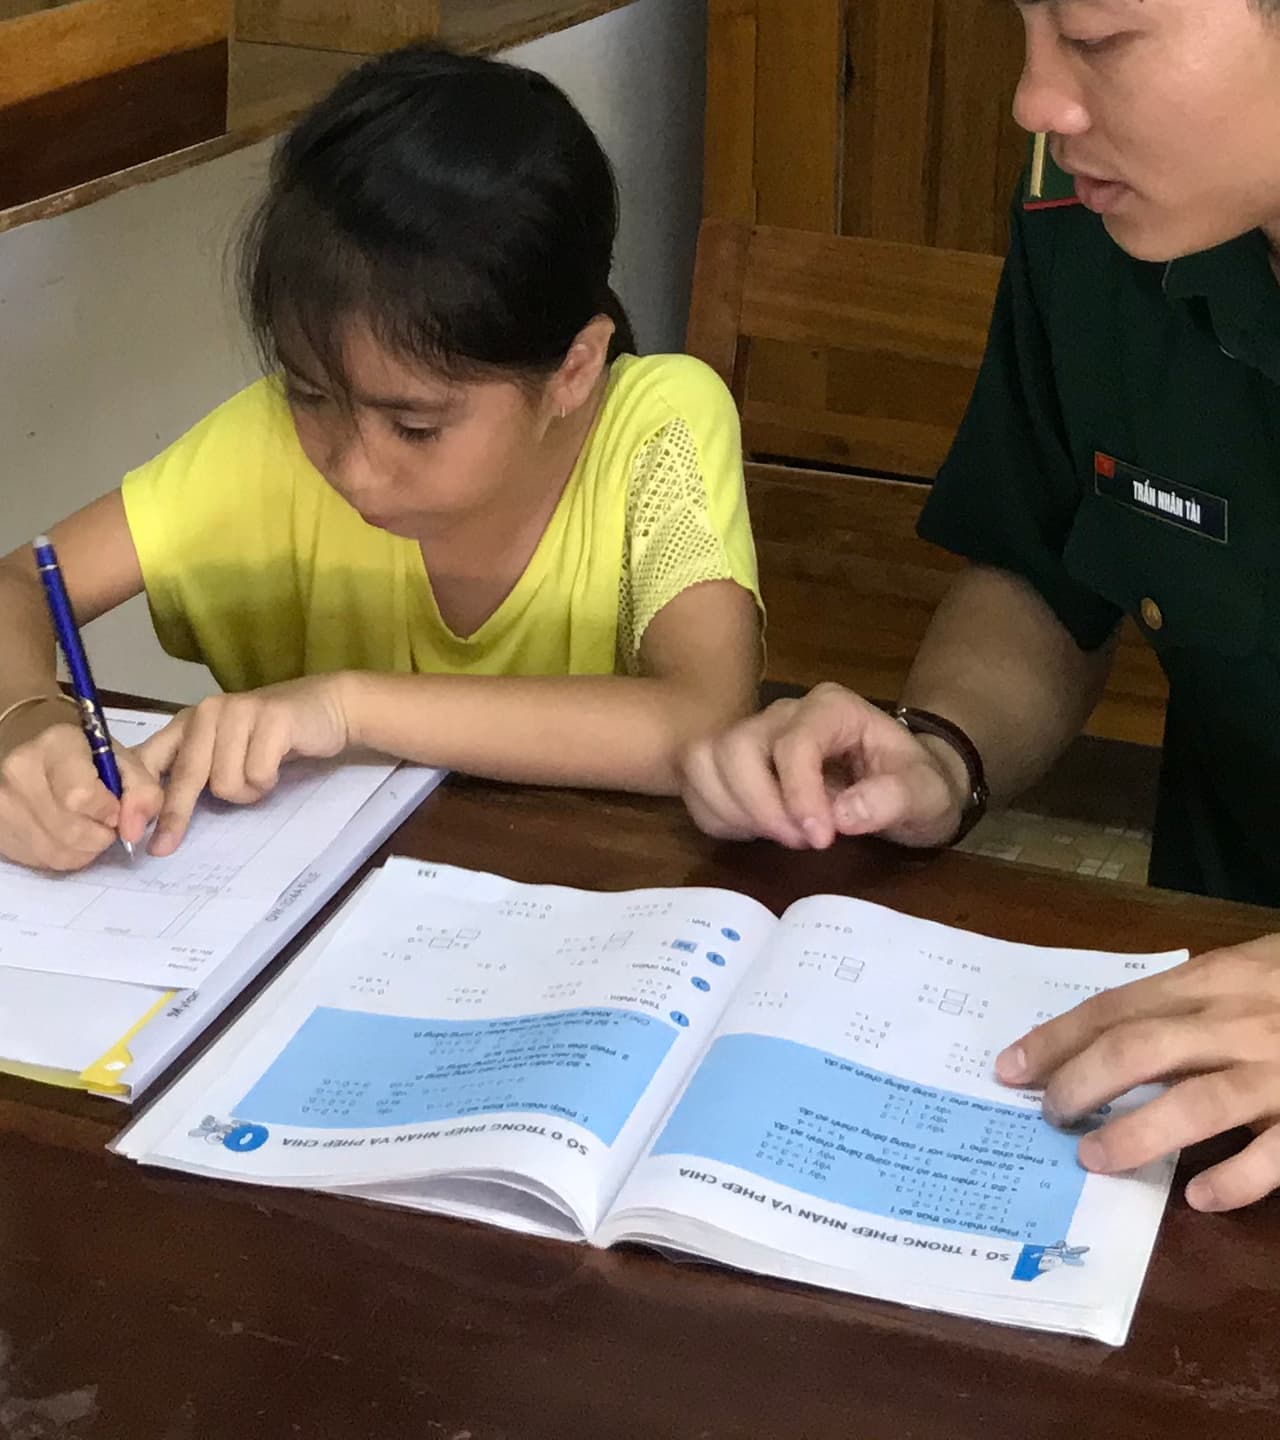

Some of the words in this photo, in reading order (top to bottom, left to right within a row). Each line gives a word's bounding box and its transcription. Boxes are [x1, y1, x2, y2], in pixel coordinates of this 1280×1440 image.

[491, 1124, 545, 1135] TRONG
[283, 1138, 319, 1147] CHIA
[680, 1168, 717, 1184] CHIA
[722, 1183, 766, 1203] PHÉP
[852, 1227, 898, 1242] PHÉP
[904, 1237, 962, 1254] TRONG
